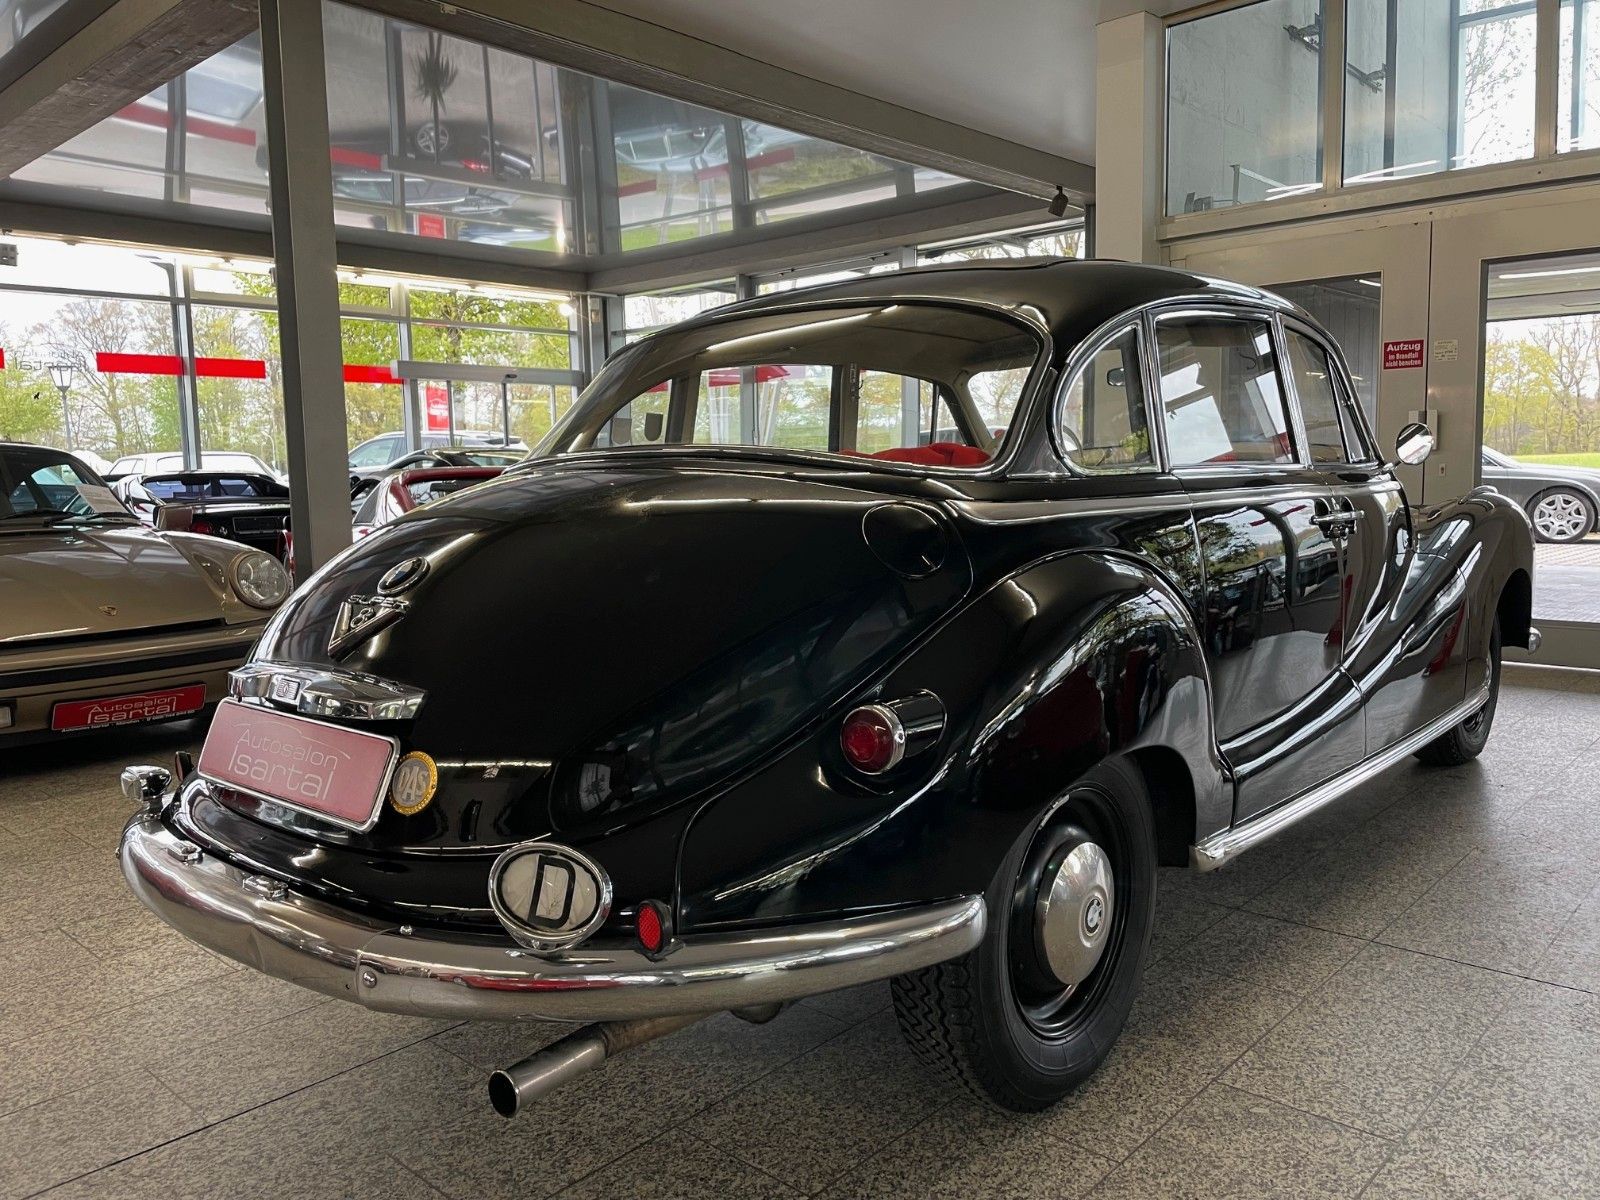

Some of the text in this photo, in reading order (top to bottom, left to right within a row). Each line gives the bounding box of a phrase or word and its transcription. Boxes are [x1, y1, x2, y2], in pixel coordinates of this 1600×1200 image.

[1386, 343, 1421, 352] Aufzug
[90, 696, 177, 713] Autosalon
[236, 728, 338, 770] Autosalon
[227, 743, 335, 801] Isartal
[526, 854, 576, 930] D
